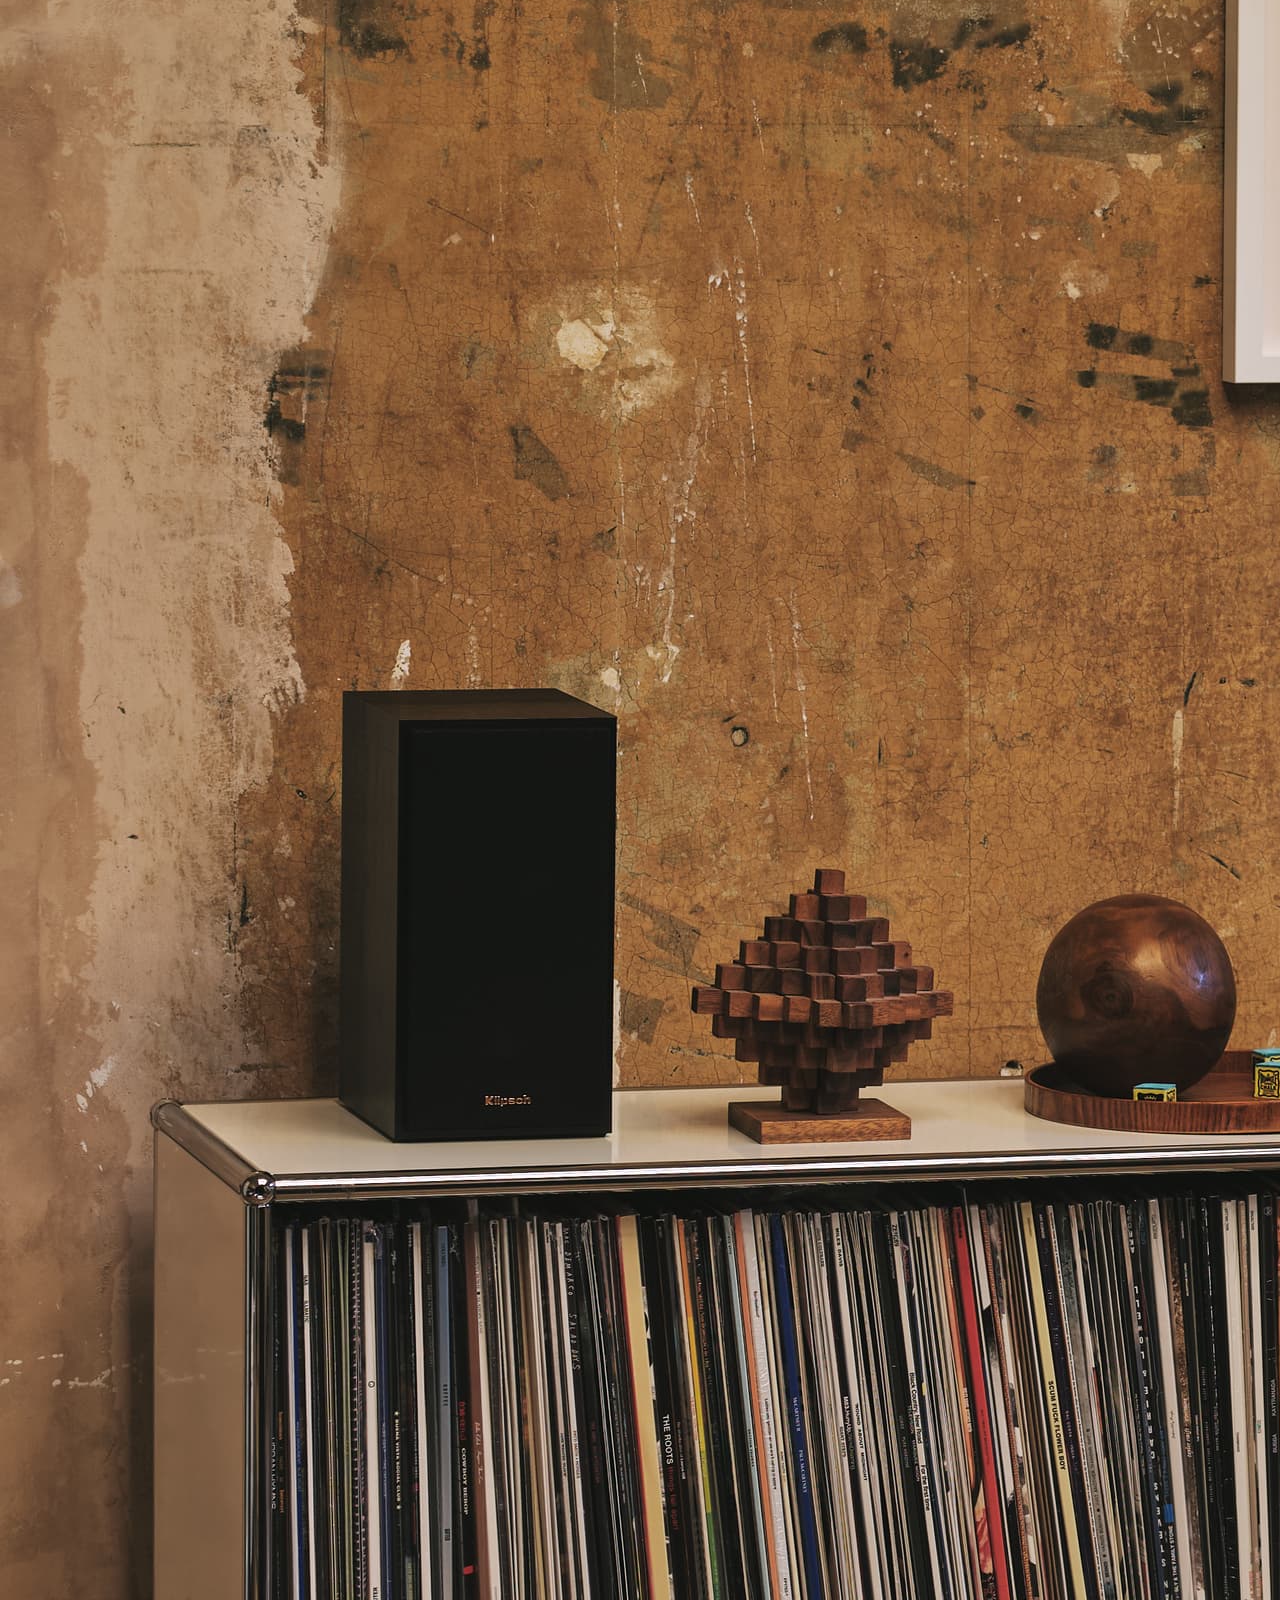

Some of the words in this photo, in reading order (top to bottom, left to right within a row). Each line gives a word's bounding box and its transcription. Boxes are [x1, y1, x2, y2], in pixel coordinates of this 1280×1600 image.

[485, 1094, 531, 1106] Klipsch
[568, 1313, 578, 1344] SALAD
[910, 1389, 919, 1413] Country,
[1048, 1381, 1056, 1402] SCUM
[661, 1414, 671, 1432] THE
[1051, 1403, 1060, 1423] FUCK
[663, 1434, 674, 1465] ROOTS
[1054, 1425, 1064, 1454] FLOWER
[860, 1452, 868, 1481] MIDNIGHT
[1170, 1544, 1178, 1565] FAMILY
